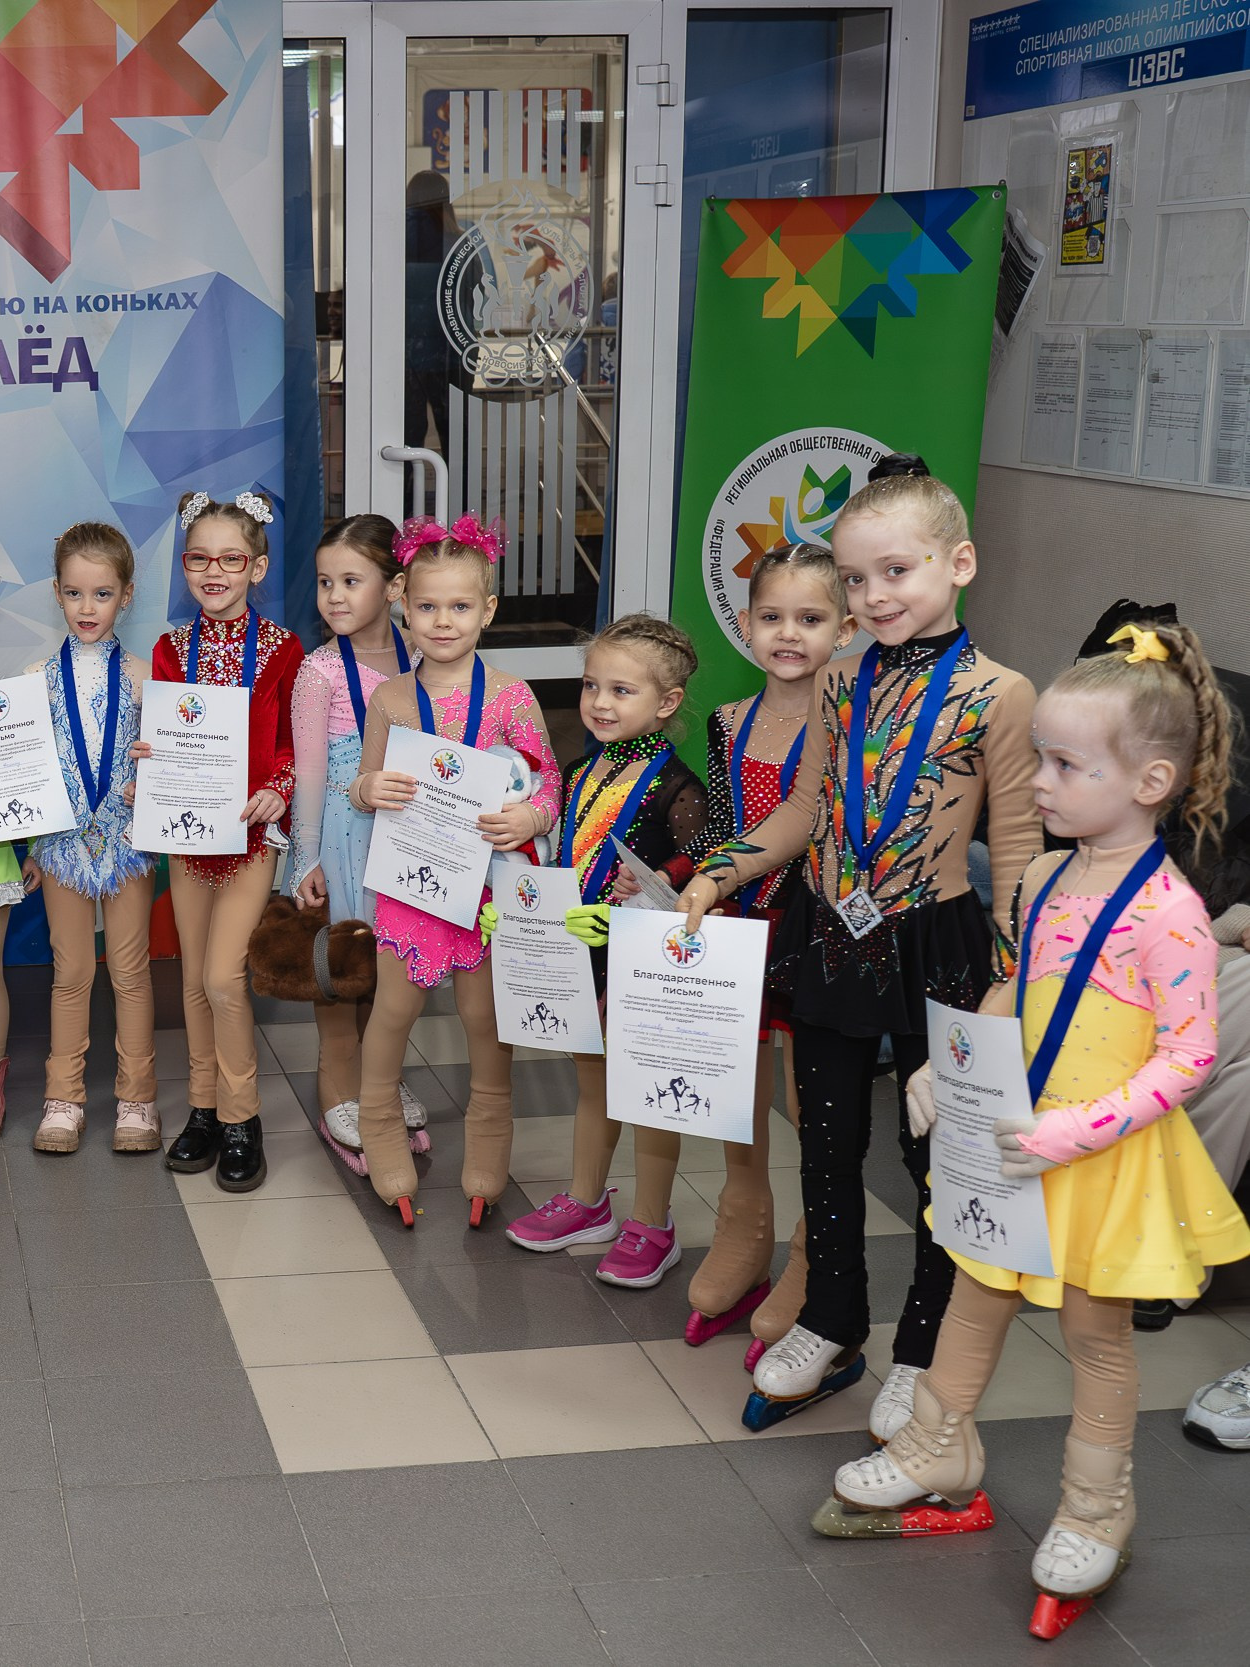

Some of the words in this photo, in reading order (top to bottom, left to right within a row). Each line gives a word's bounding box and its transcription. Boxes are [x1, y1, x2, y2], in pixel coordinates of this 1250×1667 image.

[1019, 3, 1169, 54] СПЕЦИАЛИЗИРОВАННАЯ
[1015, 44, 1093, 76] СПОРТИВНАЯ
[1095, 35, 1140, 59] ШКОЛА
[1143, 9, 1250, 48] ОЛИМПИЙСКО
[33, 295, 69, 315] НА
[76, 291, 199, 314] КОНЬКАХ
[445, 289, 470, 348] УПРАВЛЕНИЕ
[724, 443, 789, 506] РЕГИОНАЛЬНАЯ
[788, 436, 872, 461] ОБЩЕСТВЕННАЯ
[709, 518, 726, 592] «ФЕДЕРАЦИЯ
[156, 728, 229, 742] Благодарственное
[175, 741, 206, 750] письмо
[425, 792, 457, 810] письмо
[502, 912, 566, 927] Благодарственное
[519, 927, 546, 936] письмо
[633, 970, 737, 989] Благодарственное
[662, 986, 704, 998] письмо
